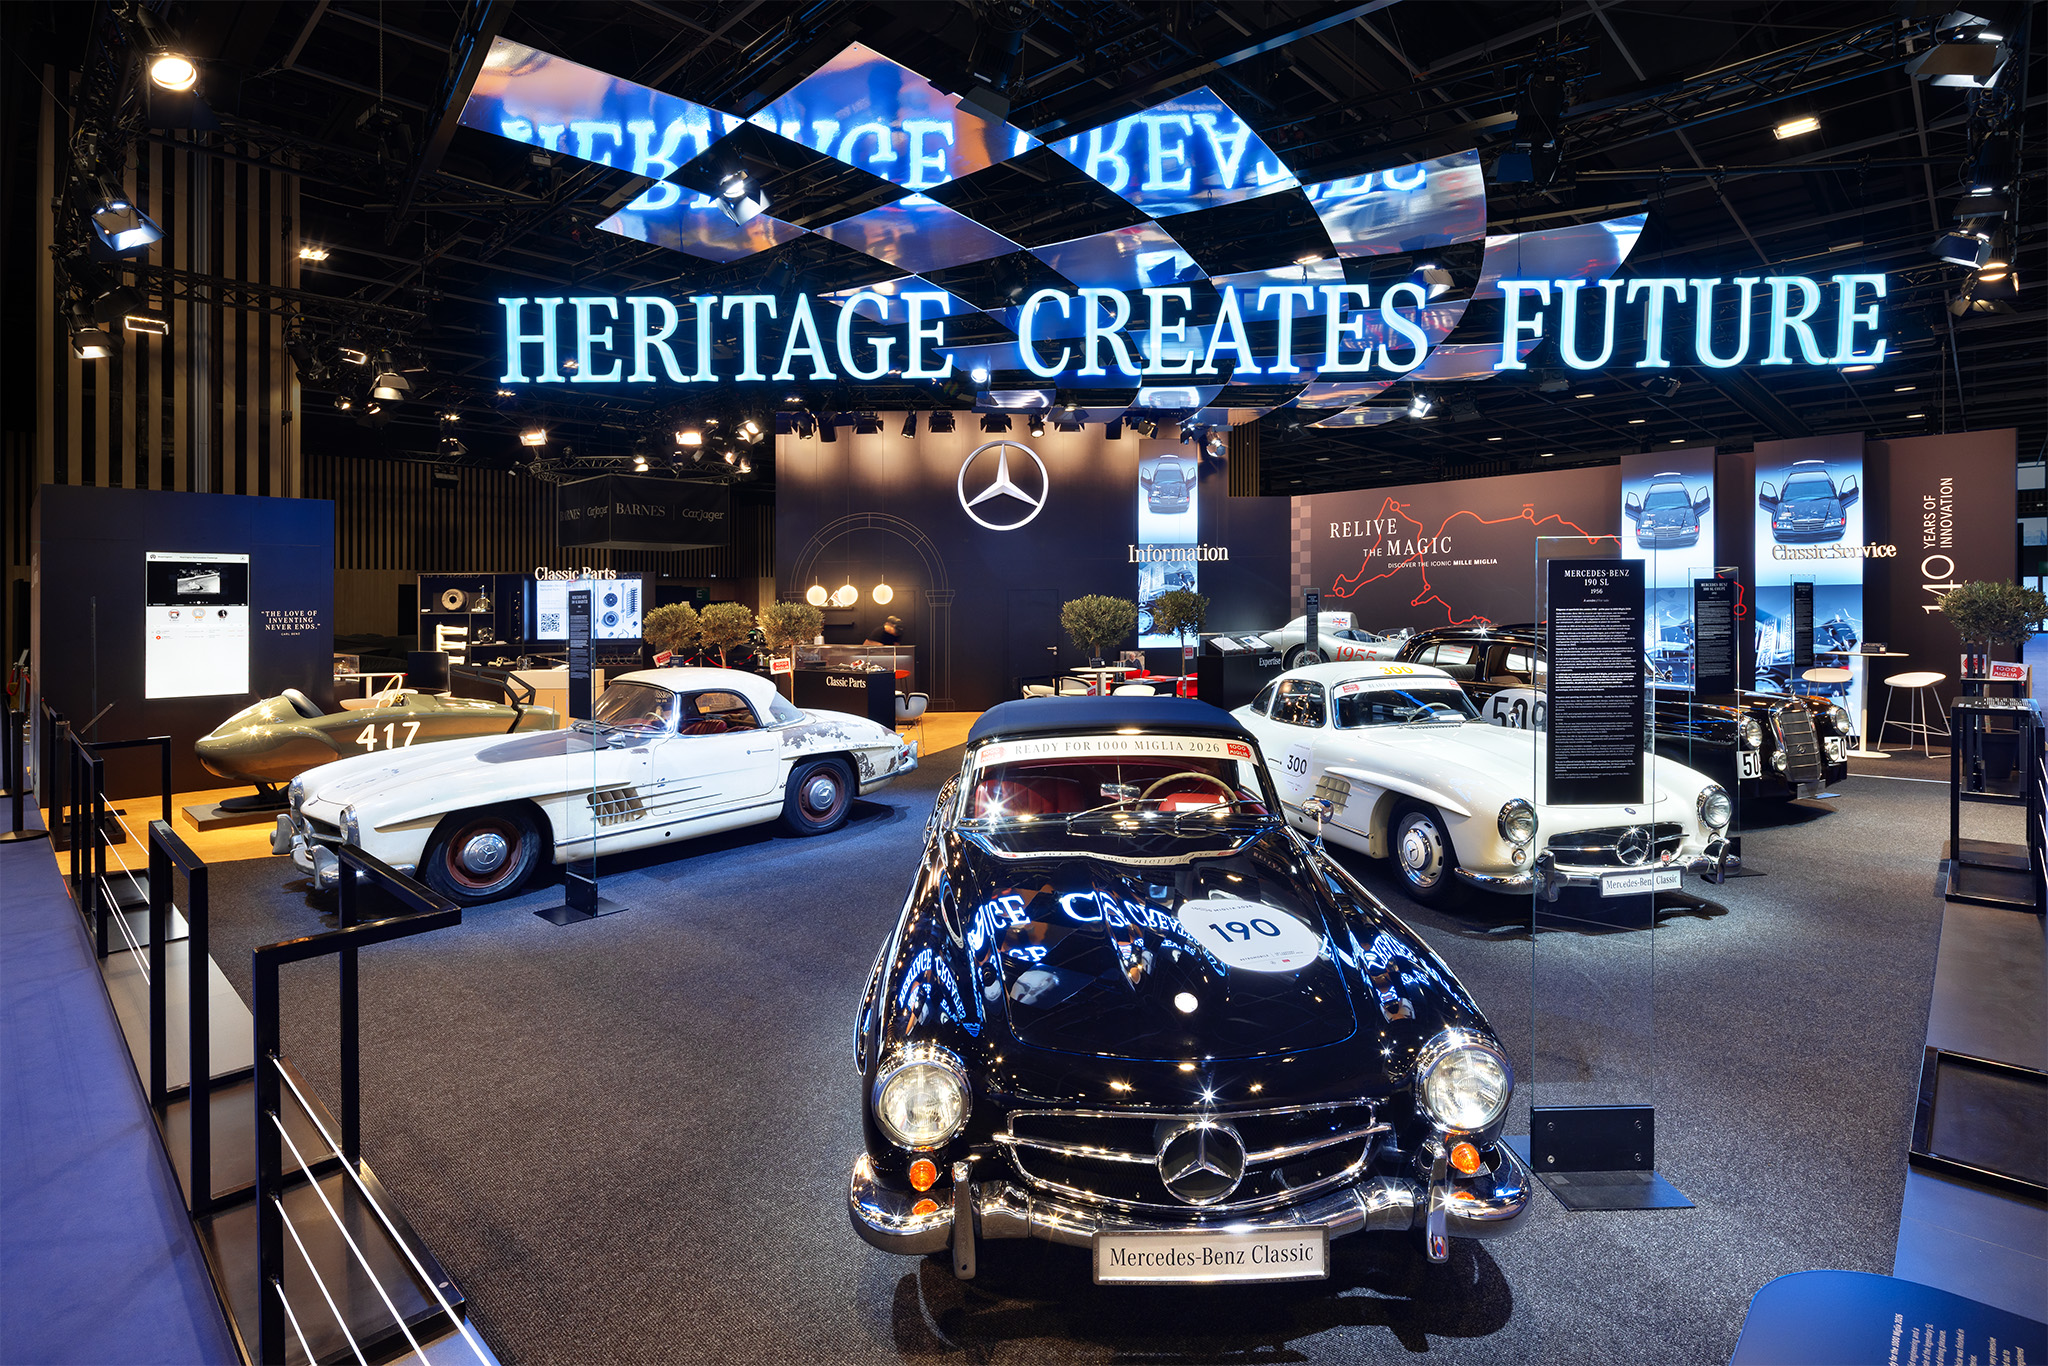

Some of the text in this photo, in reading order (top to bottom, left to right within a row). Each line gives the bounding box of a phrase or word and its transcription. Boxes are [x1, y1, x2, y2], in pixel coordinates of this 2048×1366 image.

[498, 273, 1887, 384] HERITAGE CREATES FUTURE
[616, 503, 724, 522] BARNES CarJager
[1923, 495, 1936, 549] YEARS OF
[1940, 477, 1953, 548] INNOVATION
[1330, 518, 1397, 538] RELIVE
[1128, 543, 1229, 563] Information
[1363, 536, 1452, 557] THE MAGIC
[1772, 541, 1897, 560] Classic Service
[534, 566, 579, 581] Classic
[582, 566, 617, 581] Parts
[1564, 569, 1630, 577] MERCEDES-BENZ
[1584, 578, 1609, 586] 190 SL
[1921, 554, 1963, 615] 140
[1259, 657, 1281, 667] Expertise
[1335, 646, 1377, 661] 1955
[1379, 666, 1414, 675] 300
[825, 675, 866, 688] Classic Parts
[356, 721, 421, 752] 417
[1015, 740, 1220, 754] READY FOR 1000 MIGLIA 2026
[1287, 754, 1307, 775] 300
[1606, 874, 1677, 889] Mercedes-Ben Classic
[1208, 918, 1281, 943] 190
[1110, 1243, 1313, 1267] Mercedes-Benz Classic
